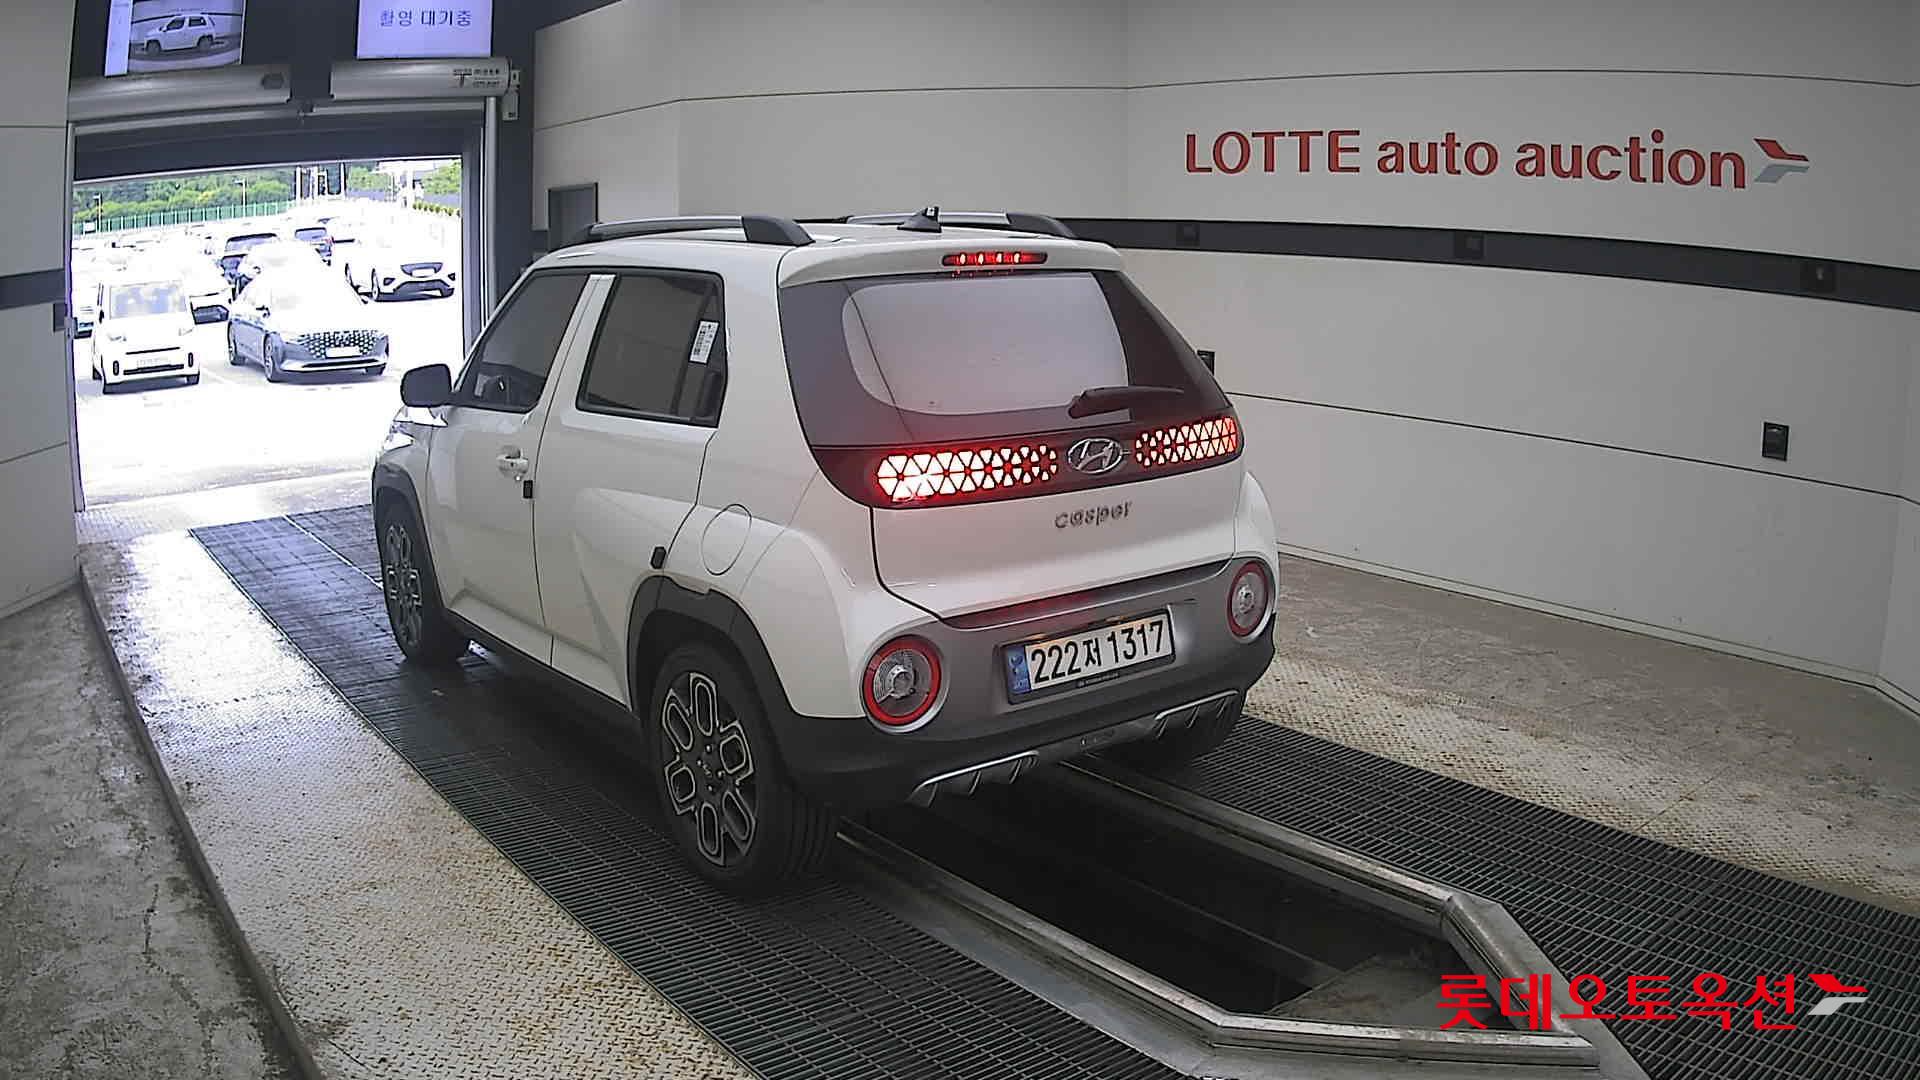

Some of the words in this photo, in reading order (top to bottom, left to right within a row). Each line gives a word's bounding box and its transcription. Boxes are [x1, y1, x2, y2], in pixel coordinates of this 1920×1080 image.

[420, 9, 472, 27] 대기중
[1185, 130, 1361, 174] LOTTE
[1377, 132, 1499, 177] auto
[1515, 129, 1747, 190] auction
[1031, 637, 1102, 684] 222저
[1107, 620, 1164, 664] 1317
